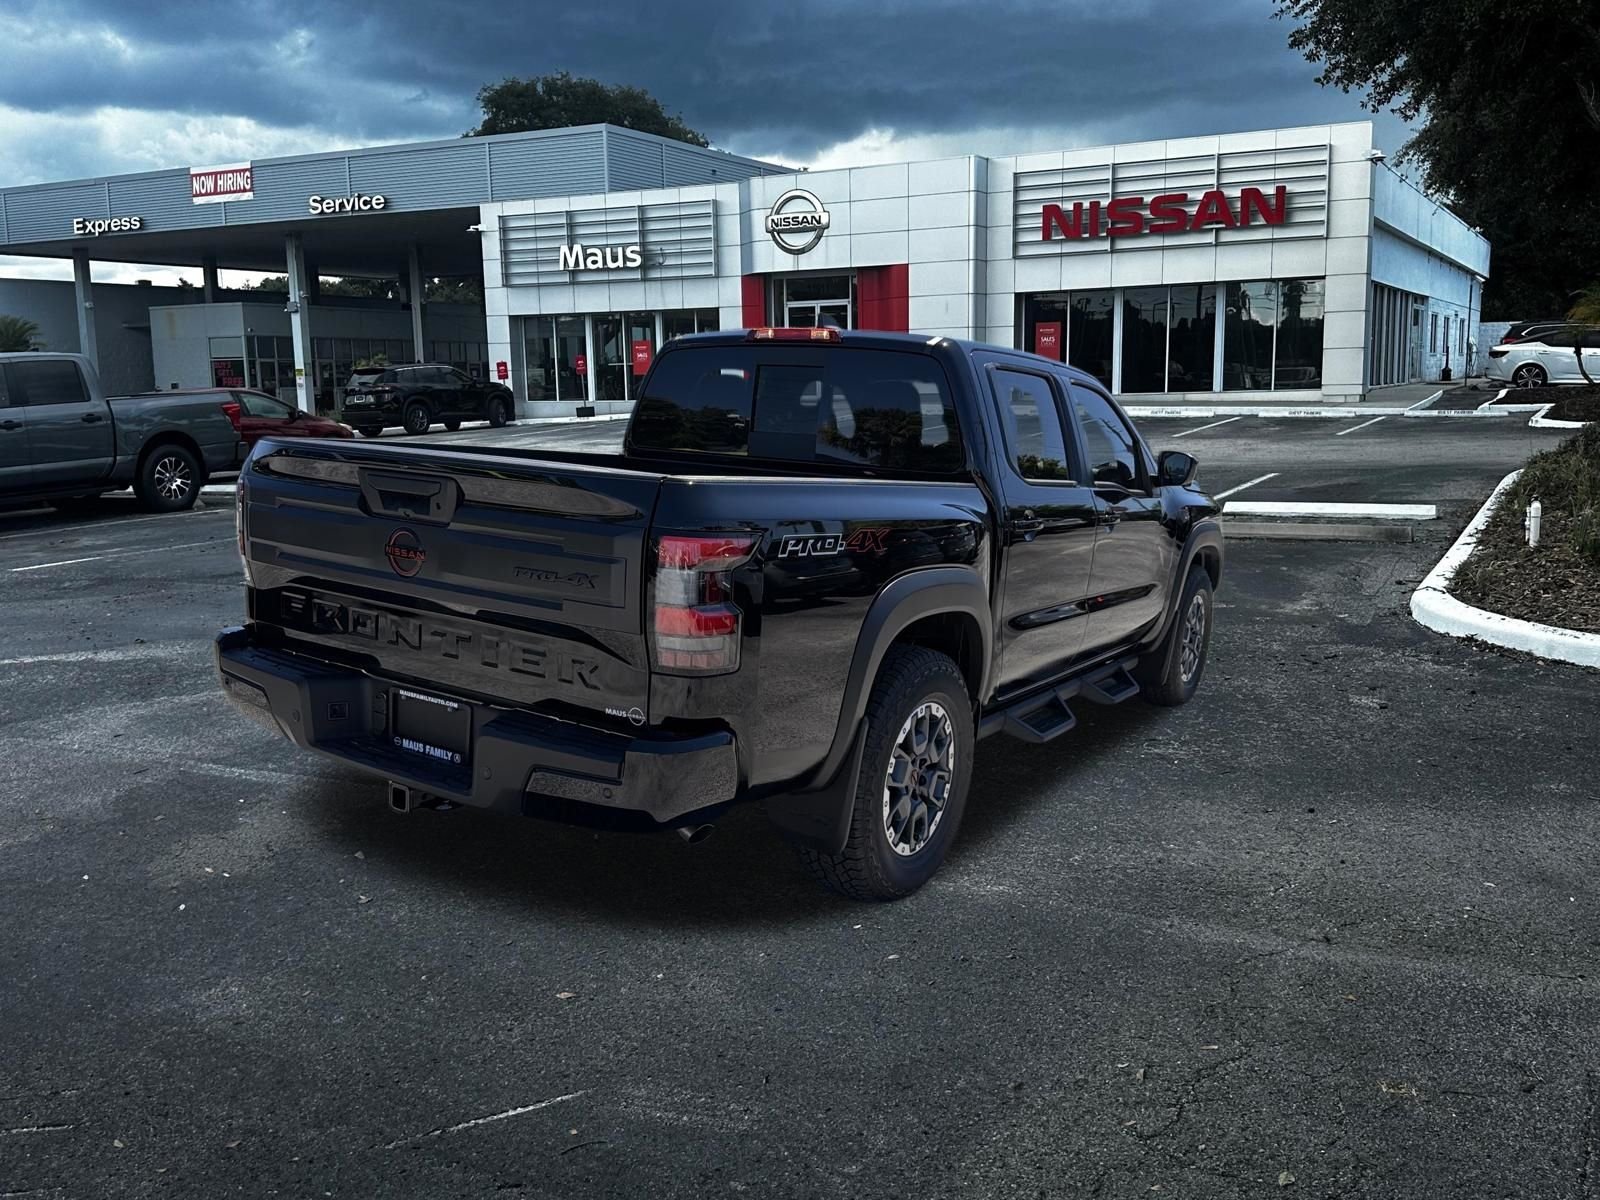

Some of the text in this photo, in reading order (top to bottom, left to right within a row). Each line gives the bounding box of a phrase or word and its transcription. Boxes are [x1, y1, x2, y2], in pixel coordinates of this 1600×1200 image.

[192, 171, 251, 195] NOW HIRING
[308, 193, 385, 214] Service
[1041, 185, 1287, 241] NISSAN
[73, 216, 141, 237] Express
[770, 214, 822, 228] NISSAN
[559, 243, 642, 271] Maus
[385, 546, 426, 561] NISSAN
[281, 591, 601, 690] FRONTIER
[605, 708, 627, 718] MAUS
[402, 738, 453, 761] MAUS FAMILY
